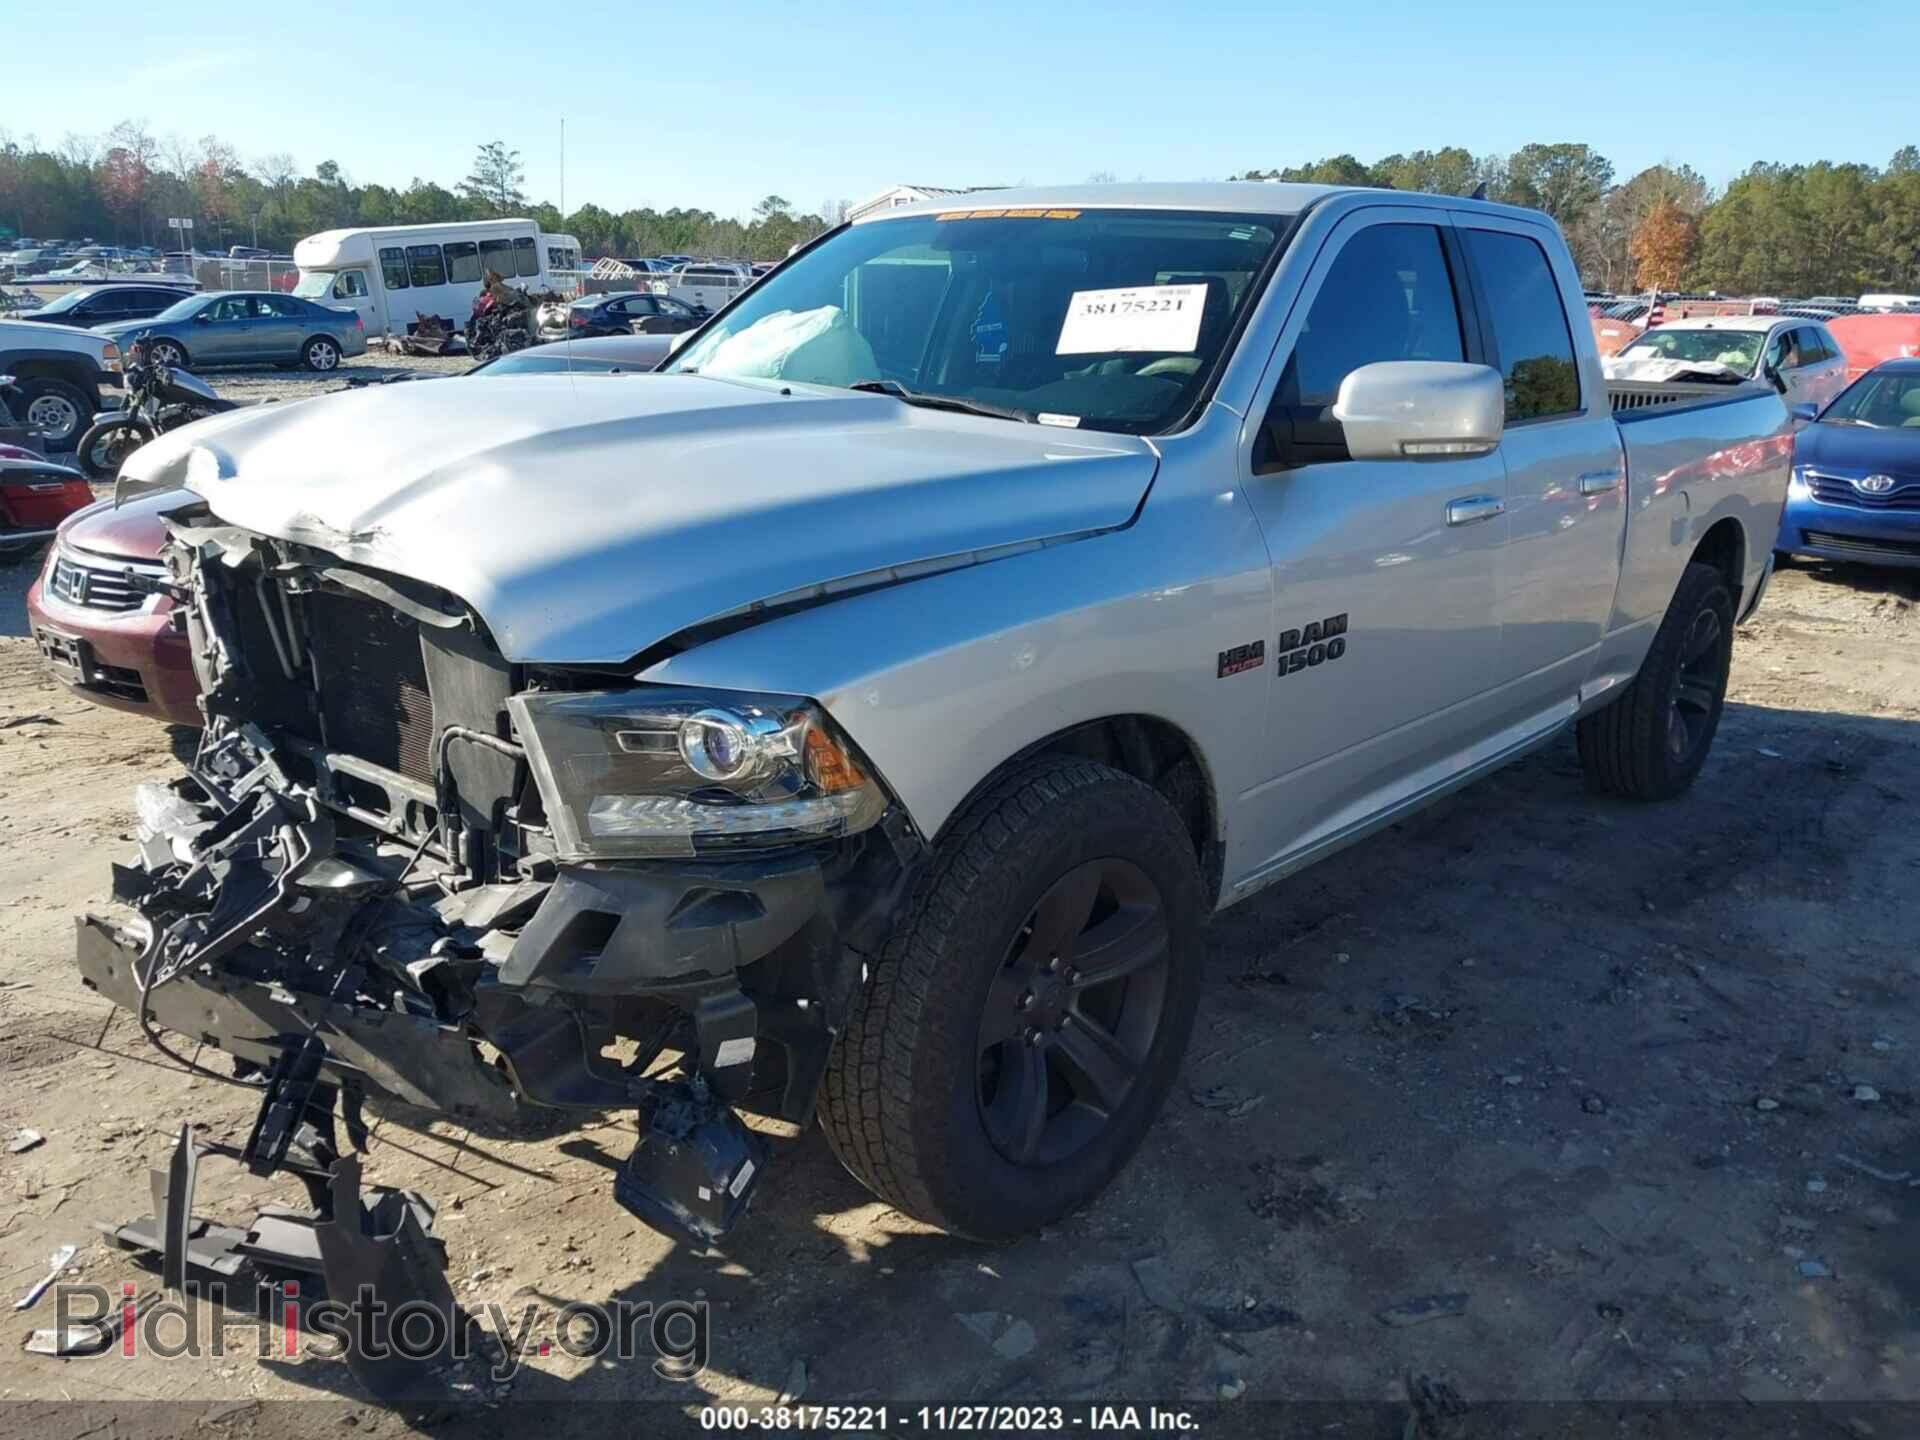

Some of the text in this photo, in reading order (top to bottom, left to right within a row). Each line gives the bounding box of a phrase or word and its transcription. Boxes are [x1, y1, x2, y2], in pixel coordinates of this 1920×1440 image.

[1081, 299, 1184, 316] 38175221
[1279, 612, 1348, 653] RAM
[1278, 637, 1346, 677] 1500
